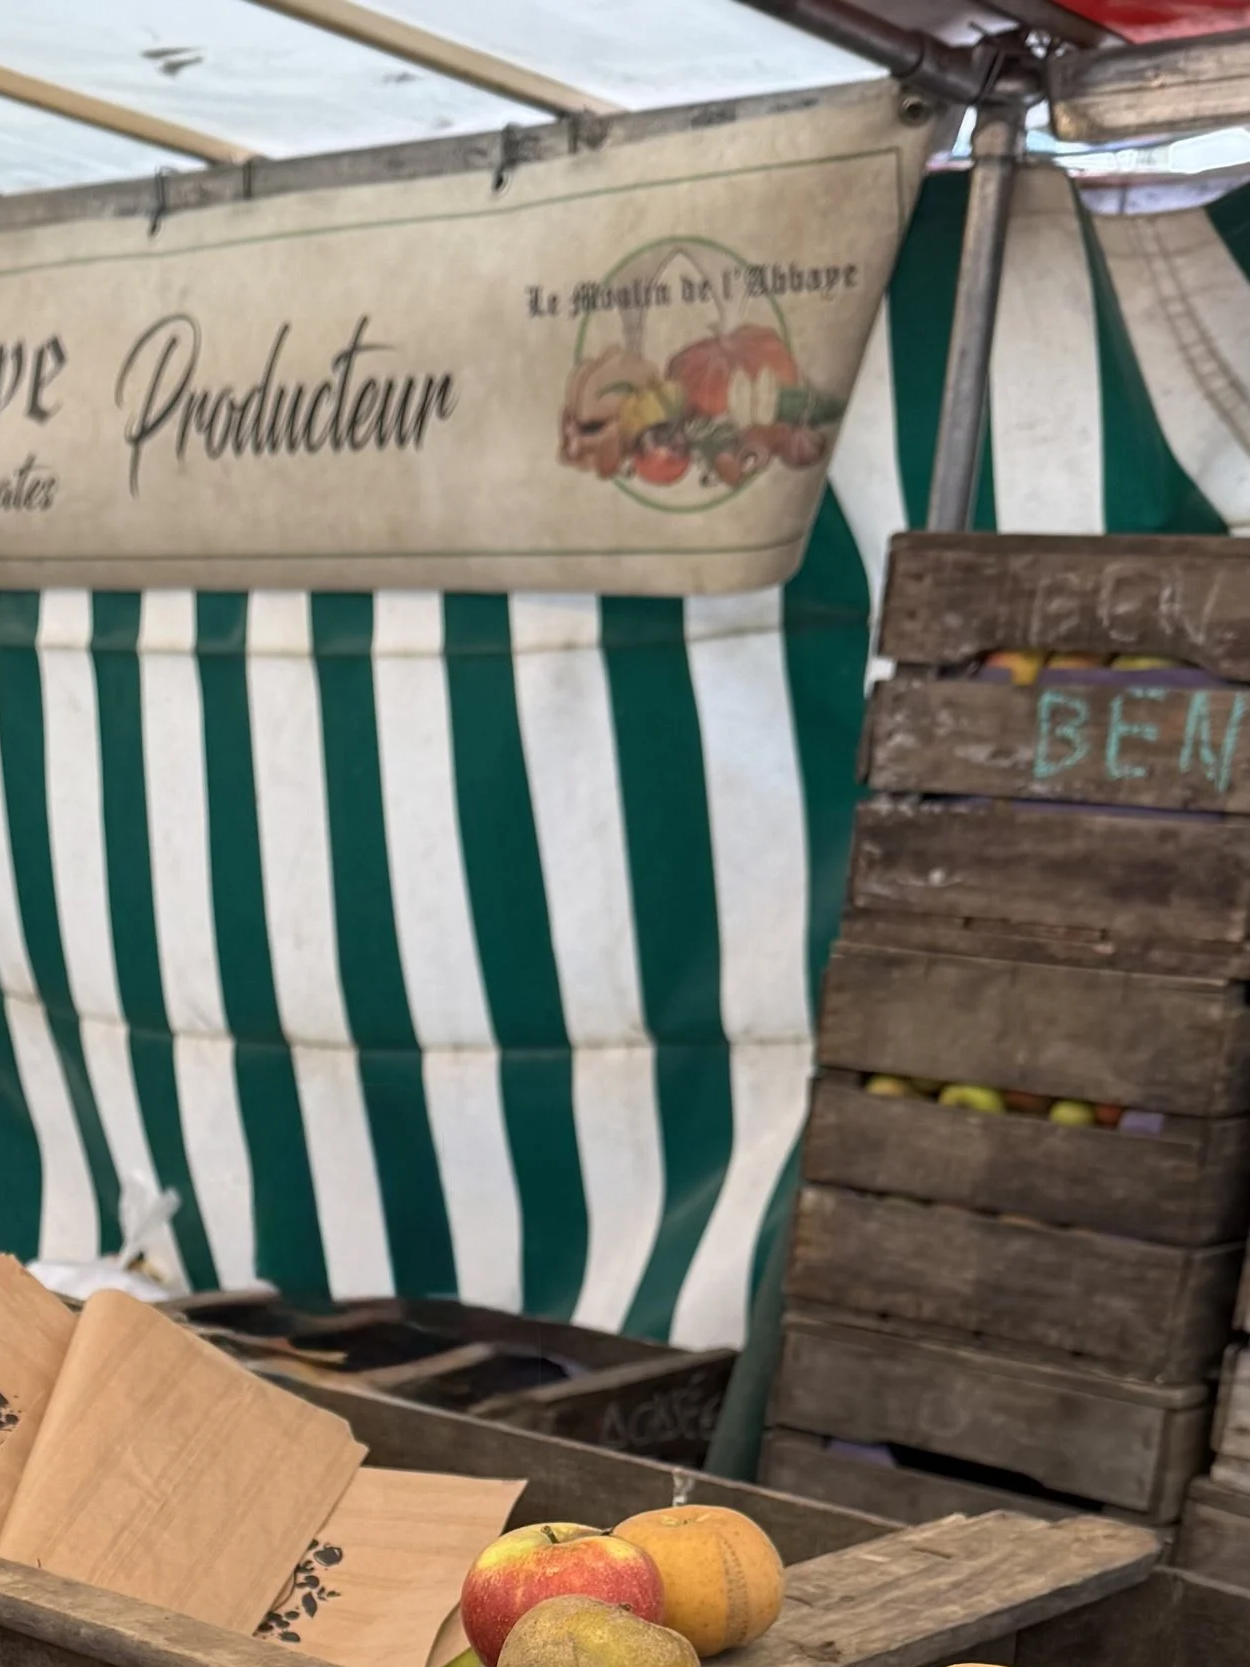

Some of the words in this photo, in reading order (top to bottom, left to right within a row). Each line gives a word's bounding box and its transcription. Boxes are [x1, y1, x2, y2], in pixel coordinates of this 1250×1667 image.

[526, 282, 558, 318] Le
[570, 276, 672, 315] Moulin
[680, 273, 712, 304] de
[115, 314, 459, 500] Producteur
[1033, 686, 1248, 793] BEN
